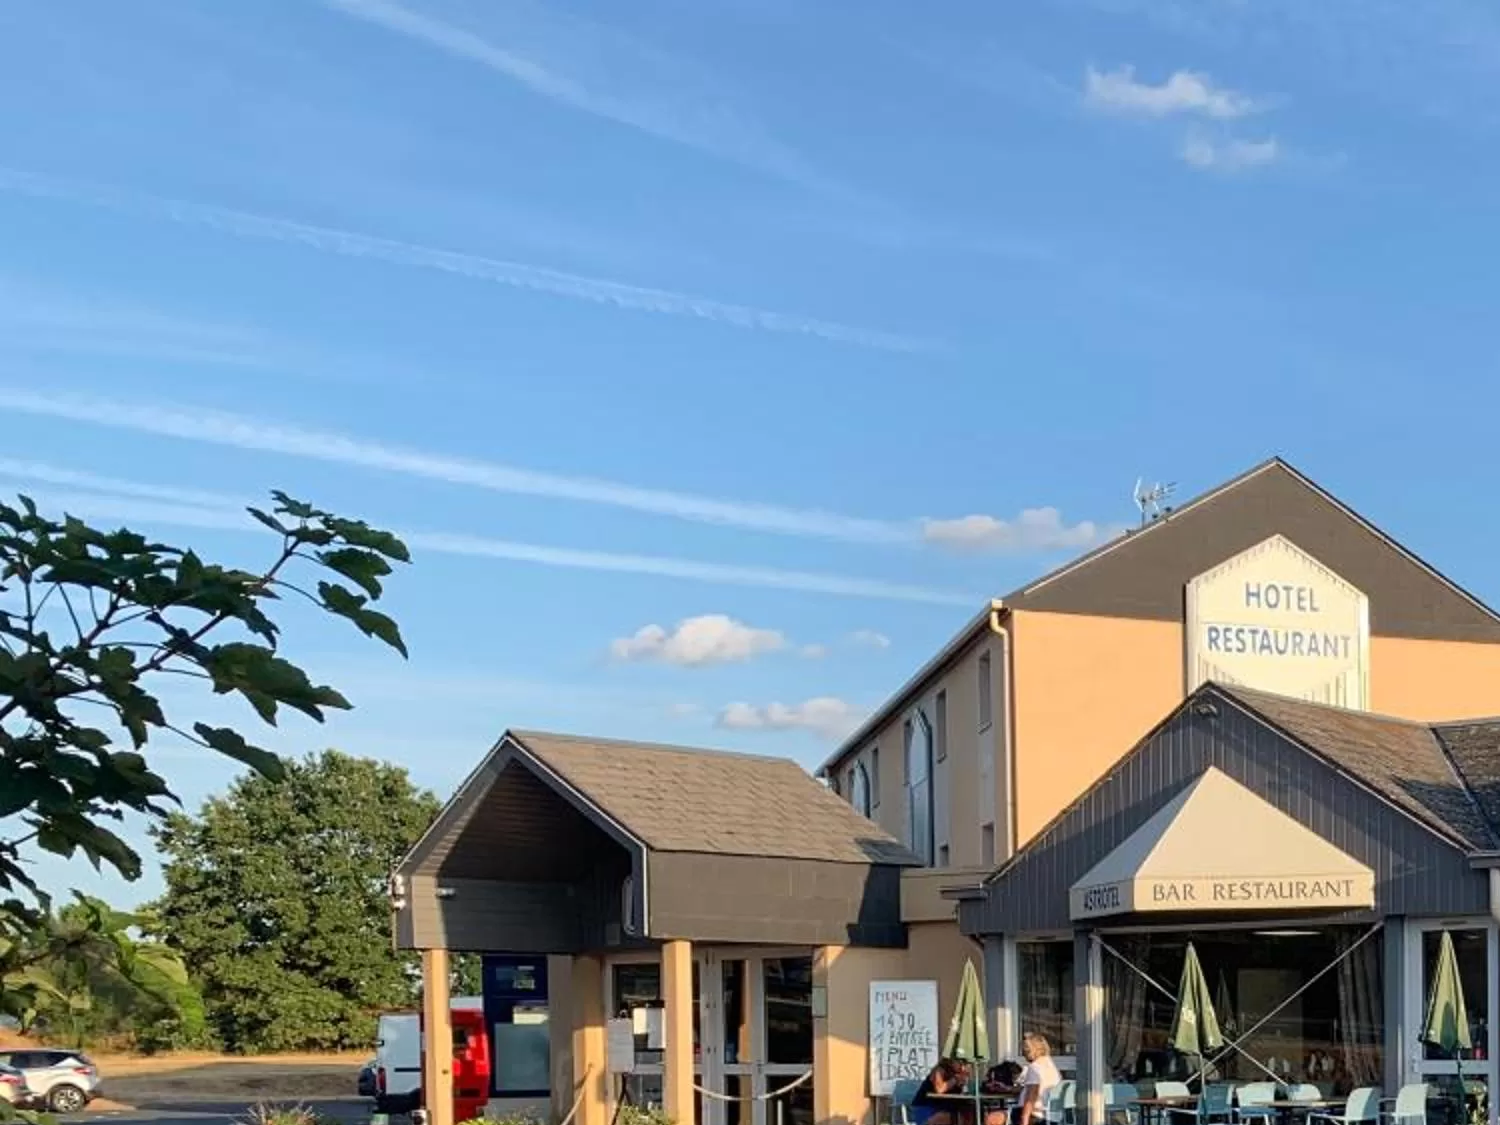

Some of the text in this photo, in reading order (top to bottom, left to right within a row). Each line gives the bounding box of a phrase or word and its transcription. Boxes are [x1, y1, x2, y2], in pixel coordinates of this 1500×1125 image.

[1245, 582, 1319, 612] HOTEL
[1207, 626, 1351, 659] RESTAURANT
[1152, 879, 1355, 902] BAR RESTAURANT
[887, 1047, 933, 1065] PLAT
